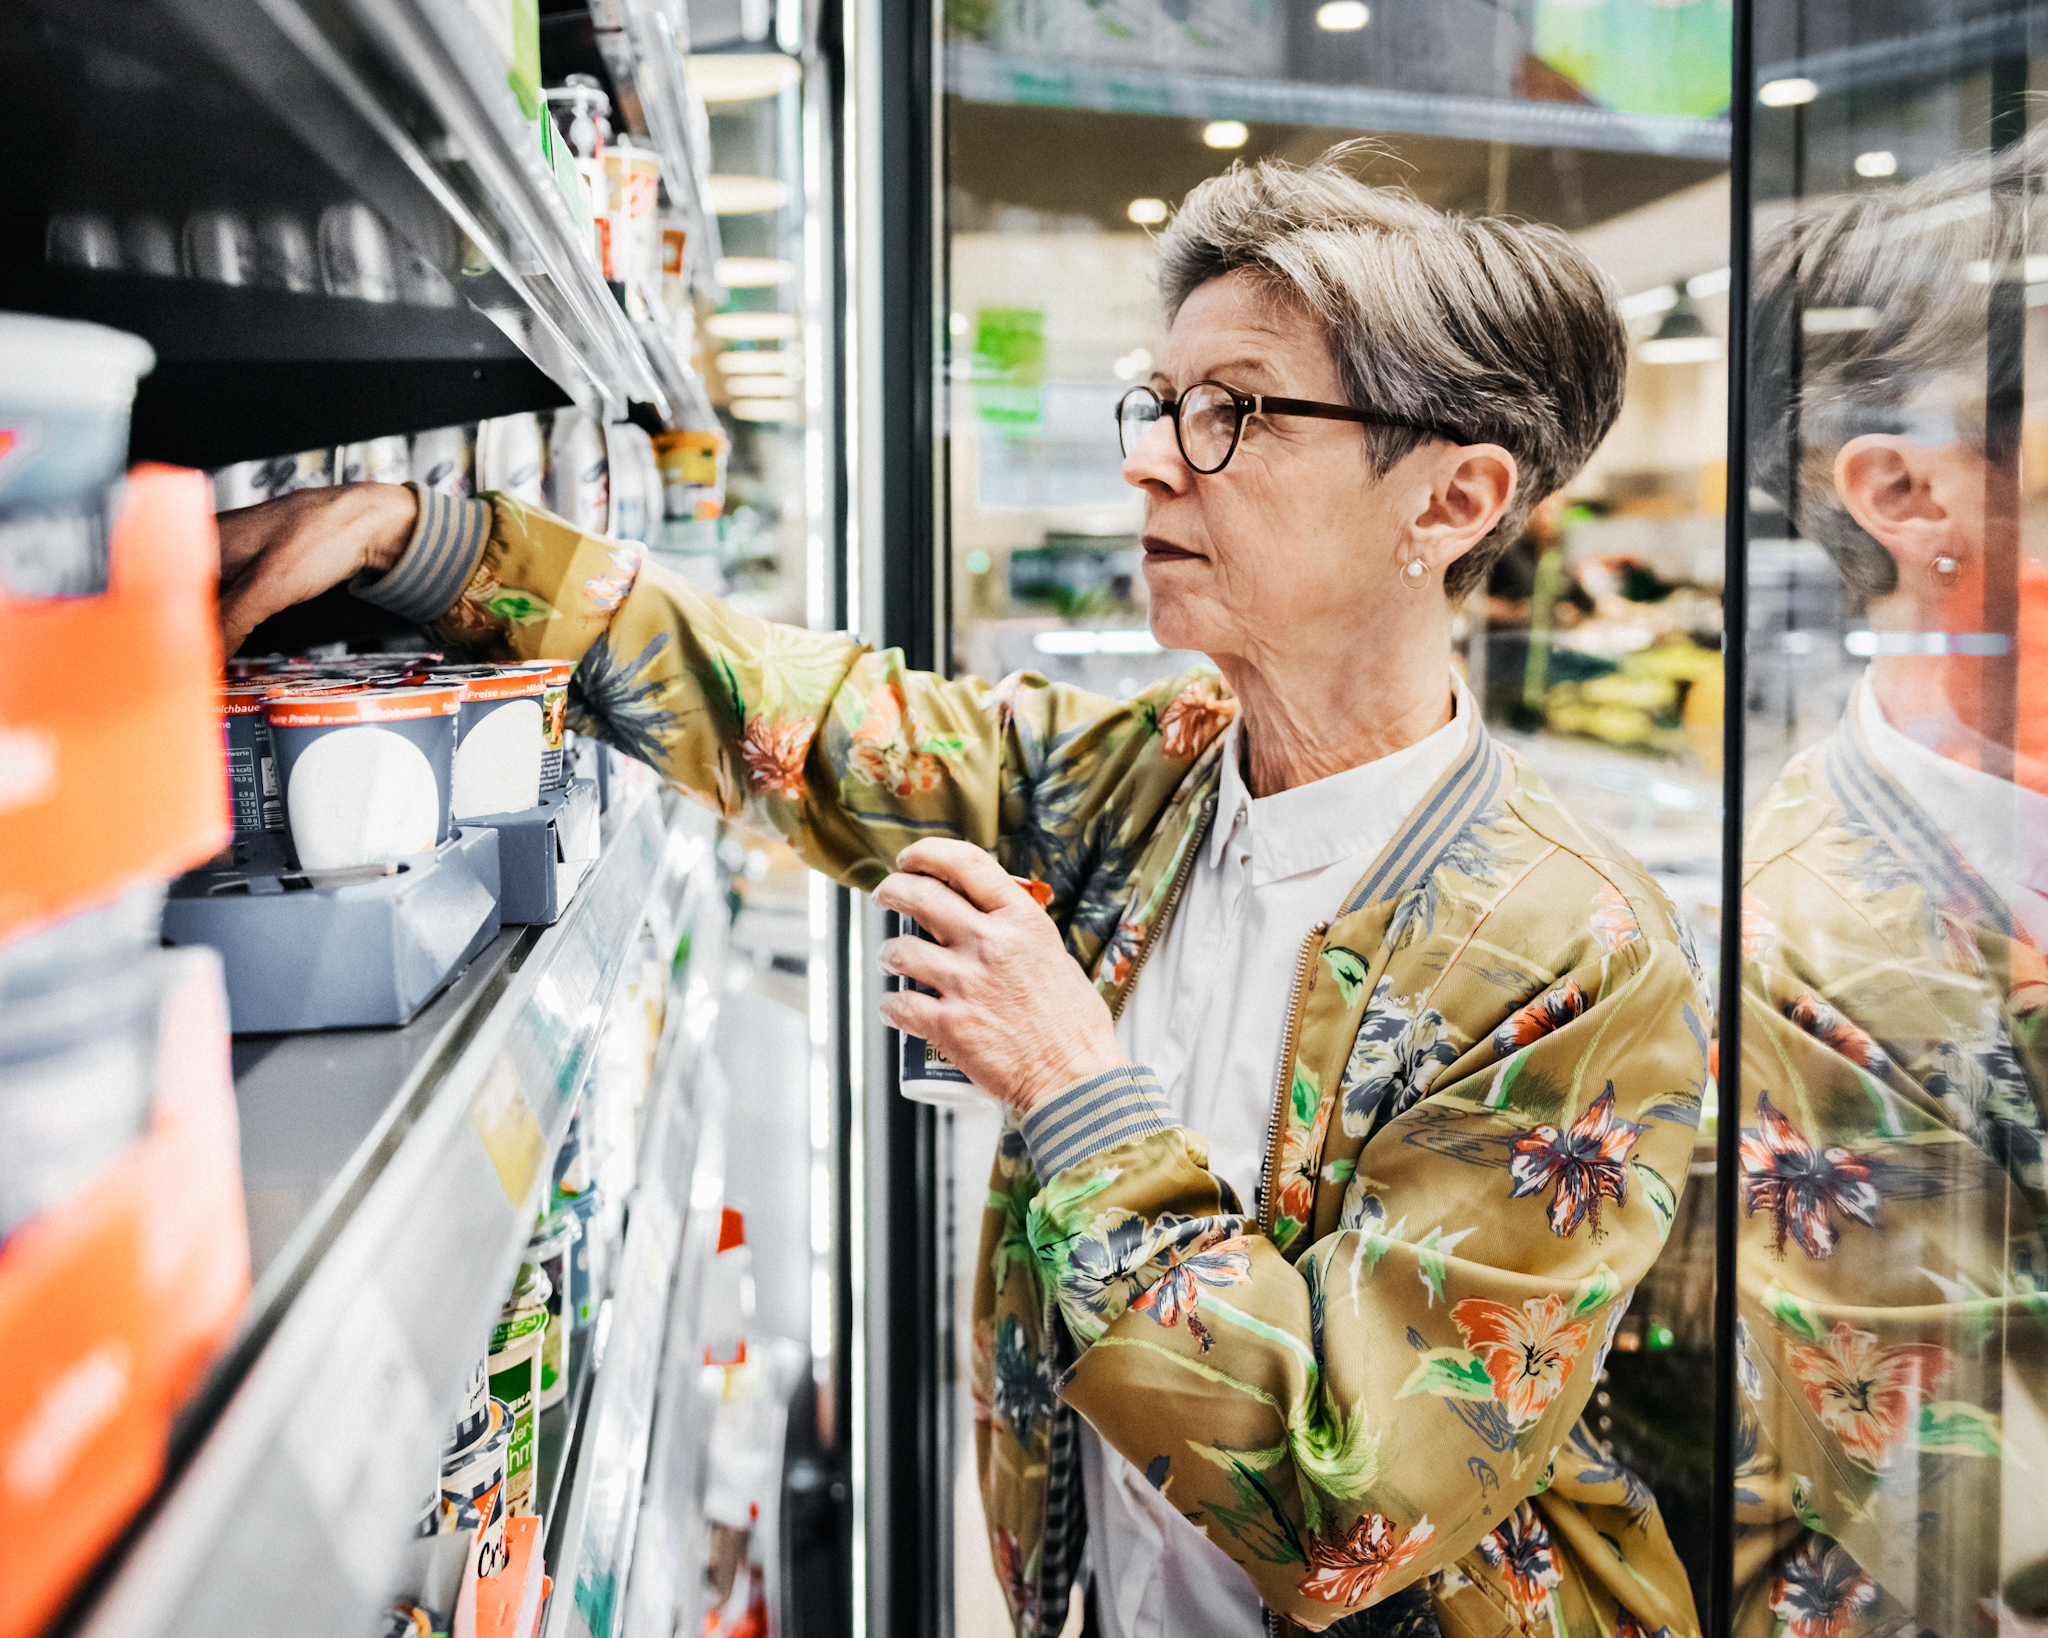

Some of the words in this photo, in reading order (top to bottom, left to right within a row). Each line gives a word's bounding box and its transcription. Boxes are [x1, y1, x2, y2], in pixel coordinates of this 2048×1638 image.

[468, 689, 498, 699] Preise
[288, 713, 320, 724] Preise
[508, 1391, 532, 1411] EKA
[509, 1422, 533, 1446] uer-
[507, 1439, 533, 1472] hm
